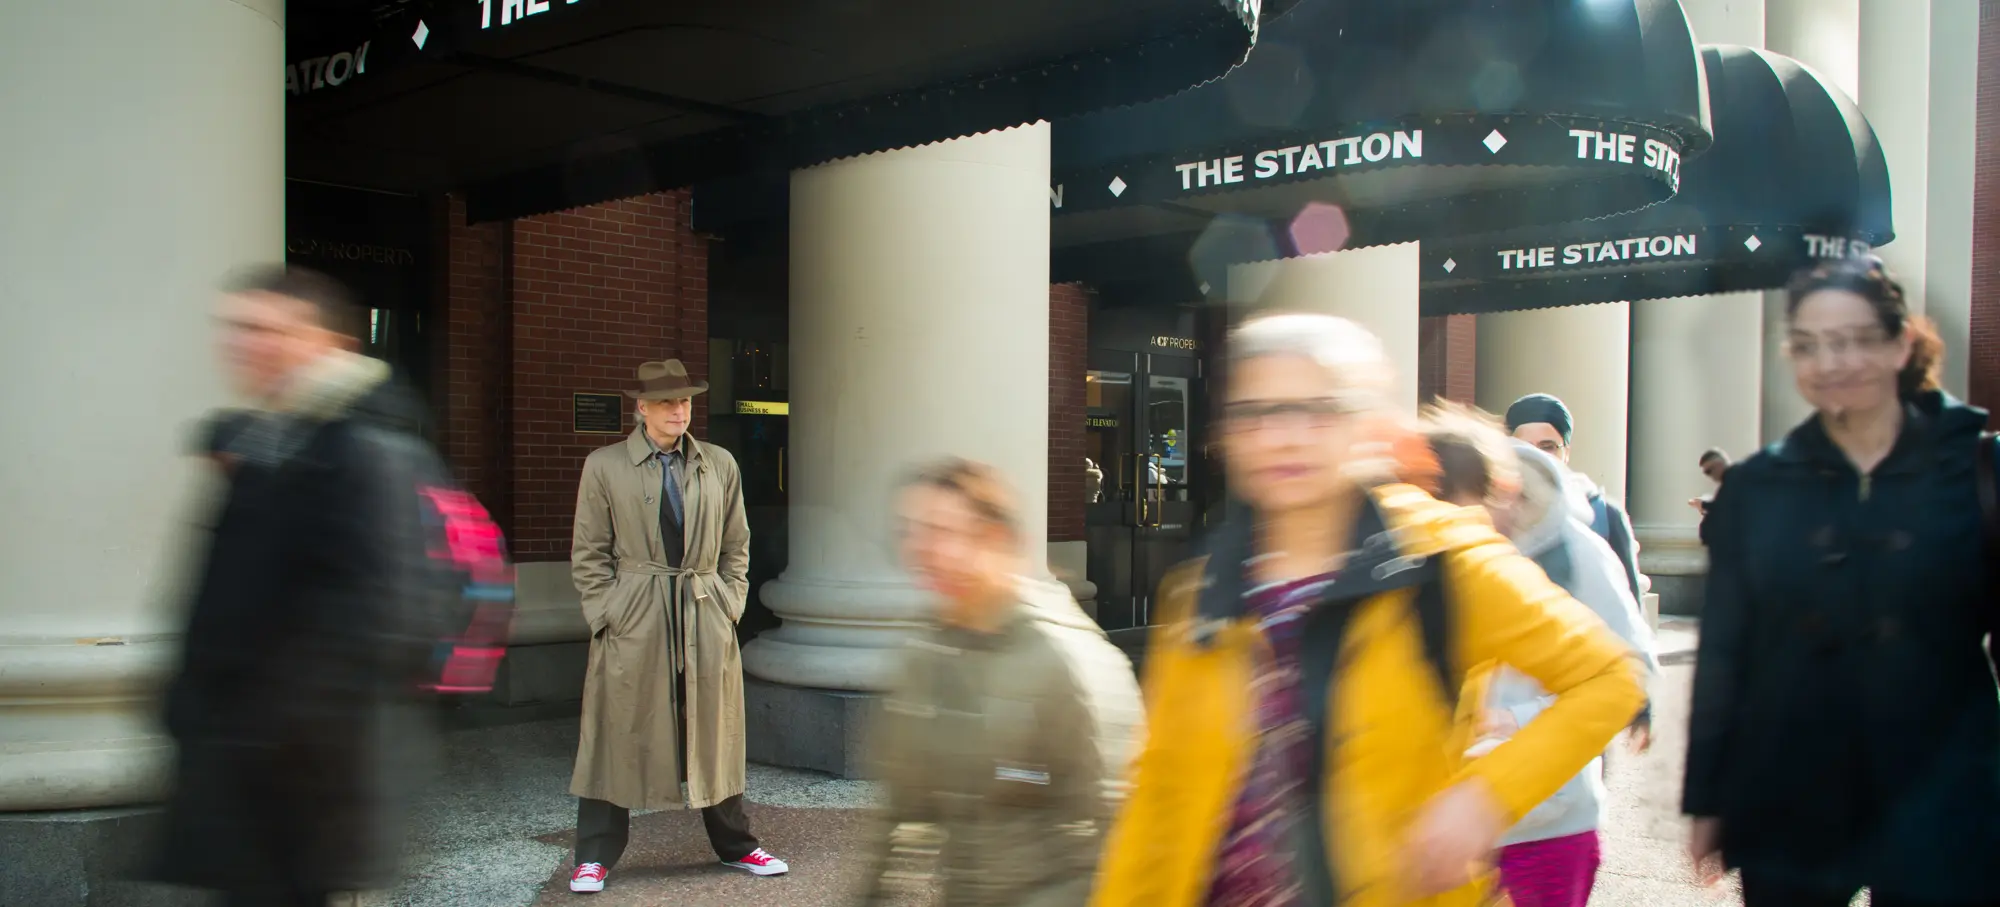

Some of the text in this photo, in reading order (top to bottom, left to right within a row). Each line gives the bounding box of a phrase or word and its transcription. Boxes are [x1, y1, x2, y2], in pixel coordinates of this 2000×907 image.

[1569, 129, 1636, 164] THE
[1175, 129, 1423, 190] THE STATION
[321, 241, 414, 265] PROPERTY
[1497, 234, 1696, 269] THE STATION
[1803, 234, 1846, 259] THE
[1150, 335, 1158, 347] A
[1092, 418, 1118, 428] ELEVATO
